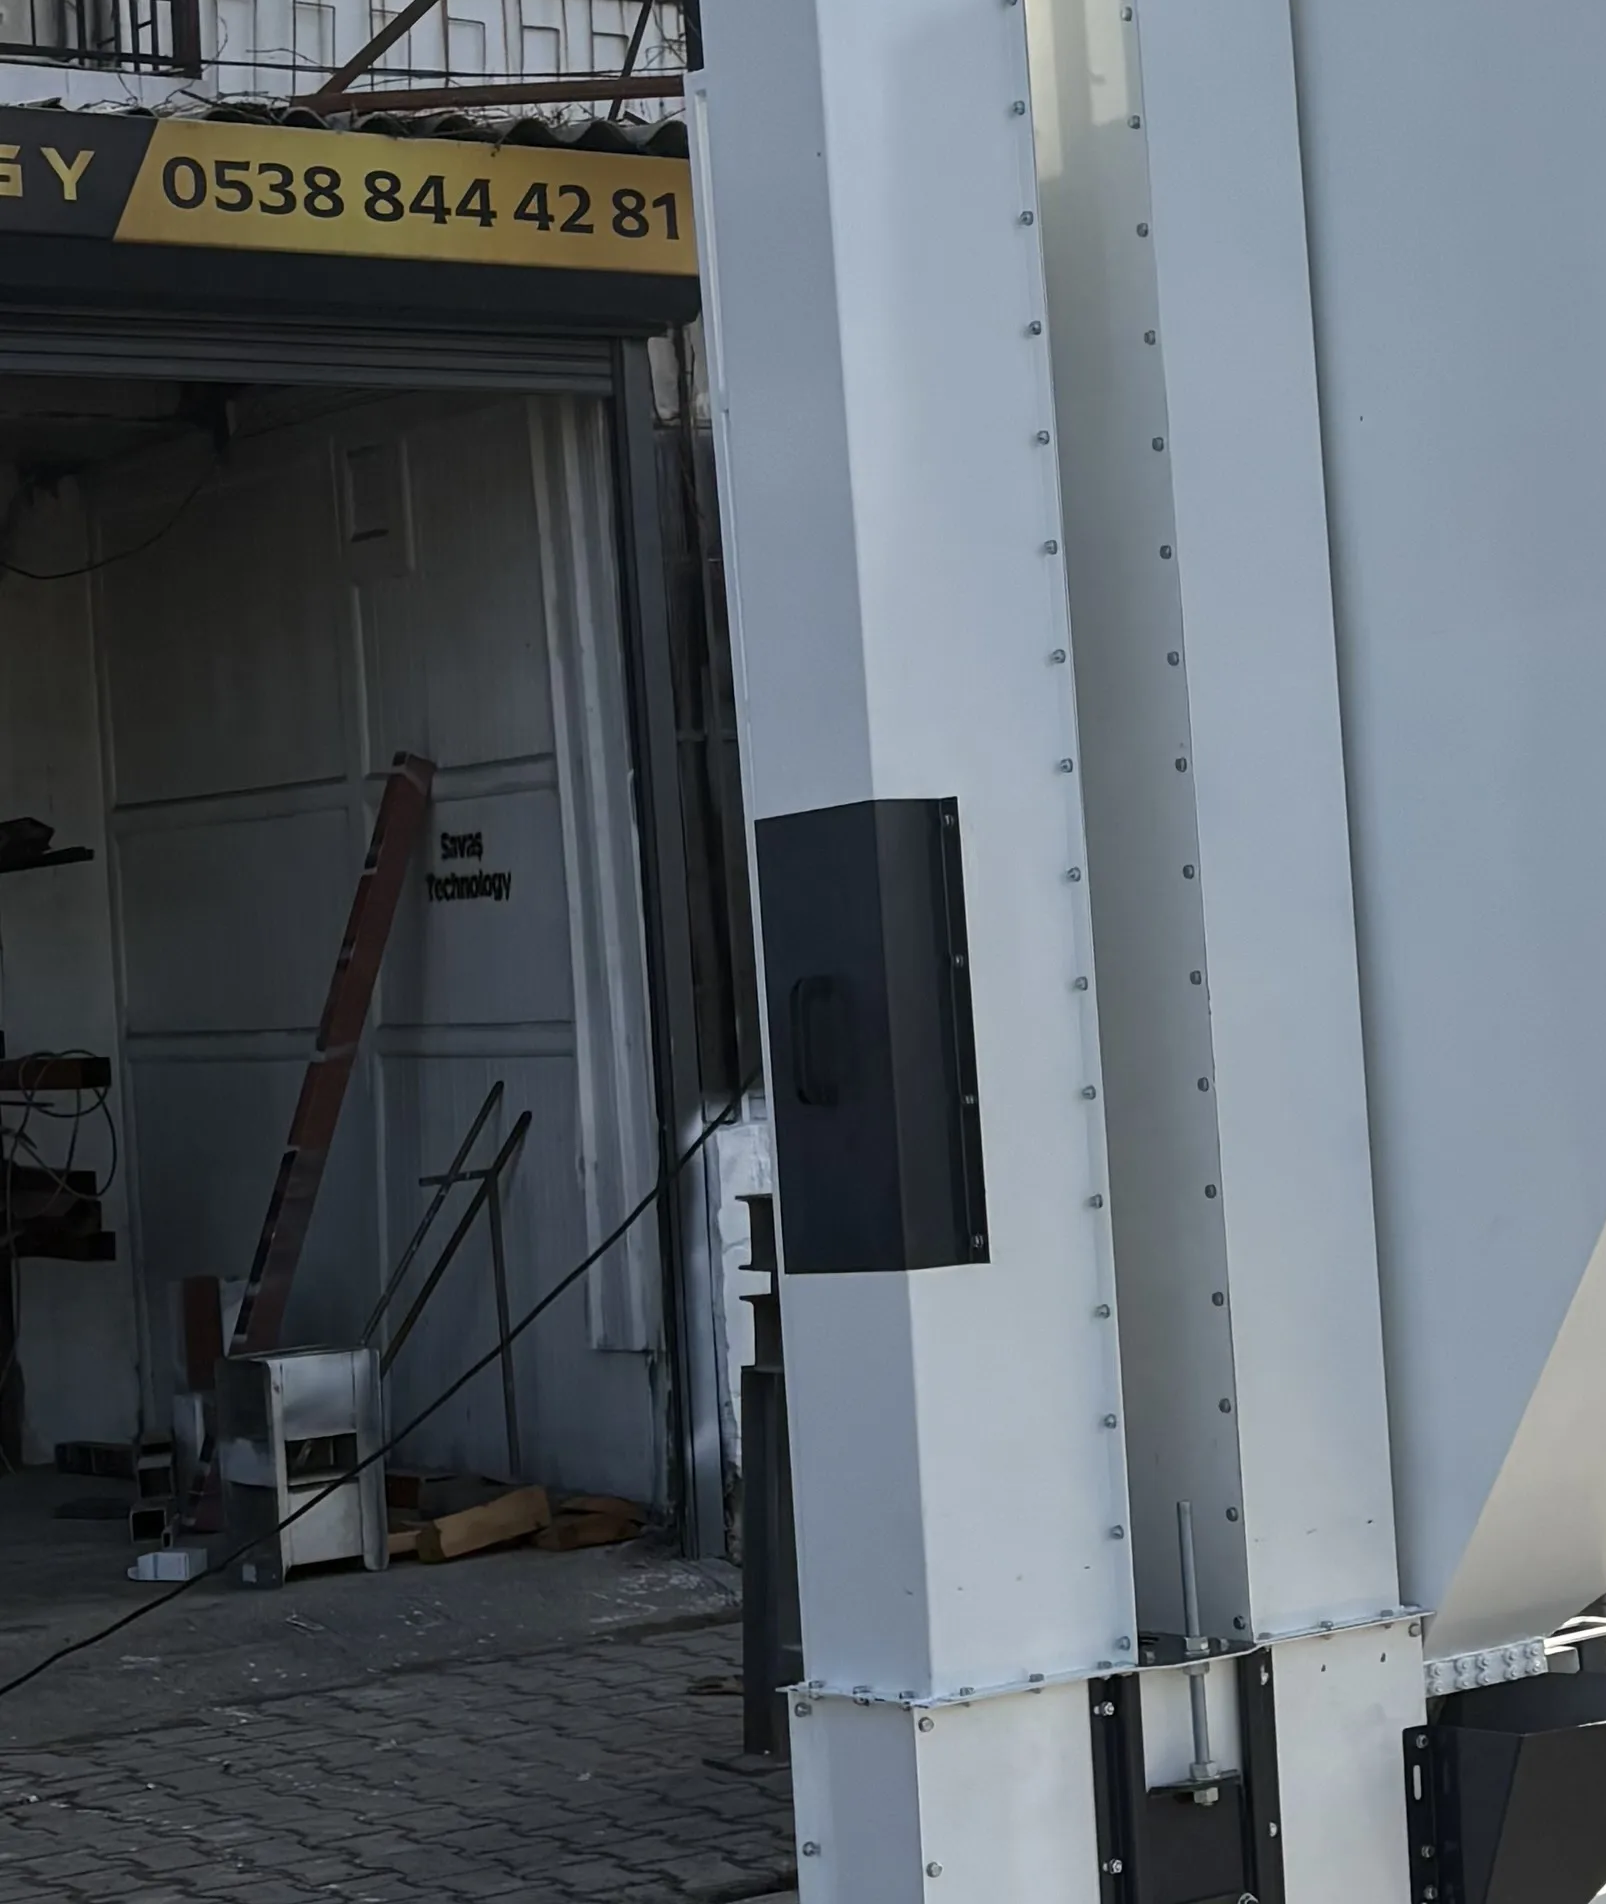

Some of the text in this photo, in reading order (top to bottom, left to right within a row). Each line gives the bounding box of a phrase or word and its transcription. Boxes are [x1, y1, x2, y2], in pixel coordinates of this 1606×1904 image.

[161, 155, 345, 219] 0538
[363, 169, 498, 227] 844
[513, 181, 595, 234] 42
[611, 188, 681, 240] 81
[425, 868, 512, 902] Technology
